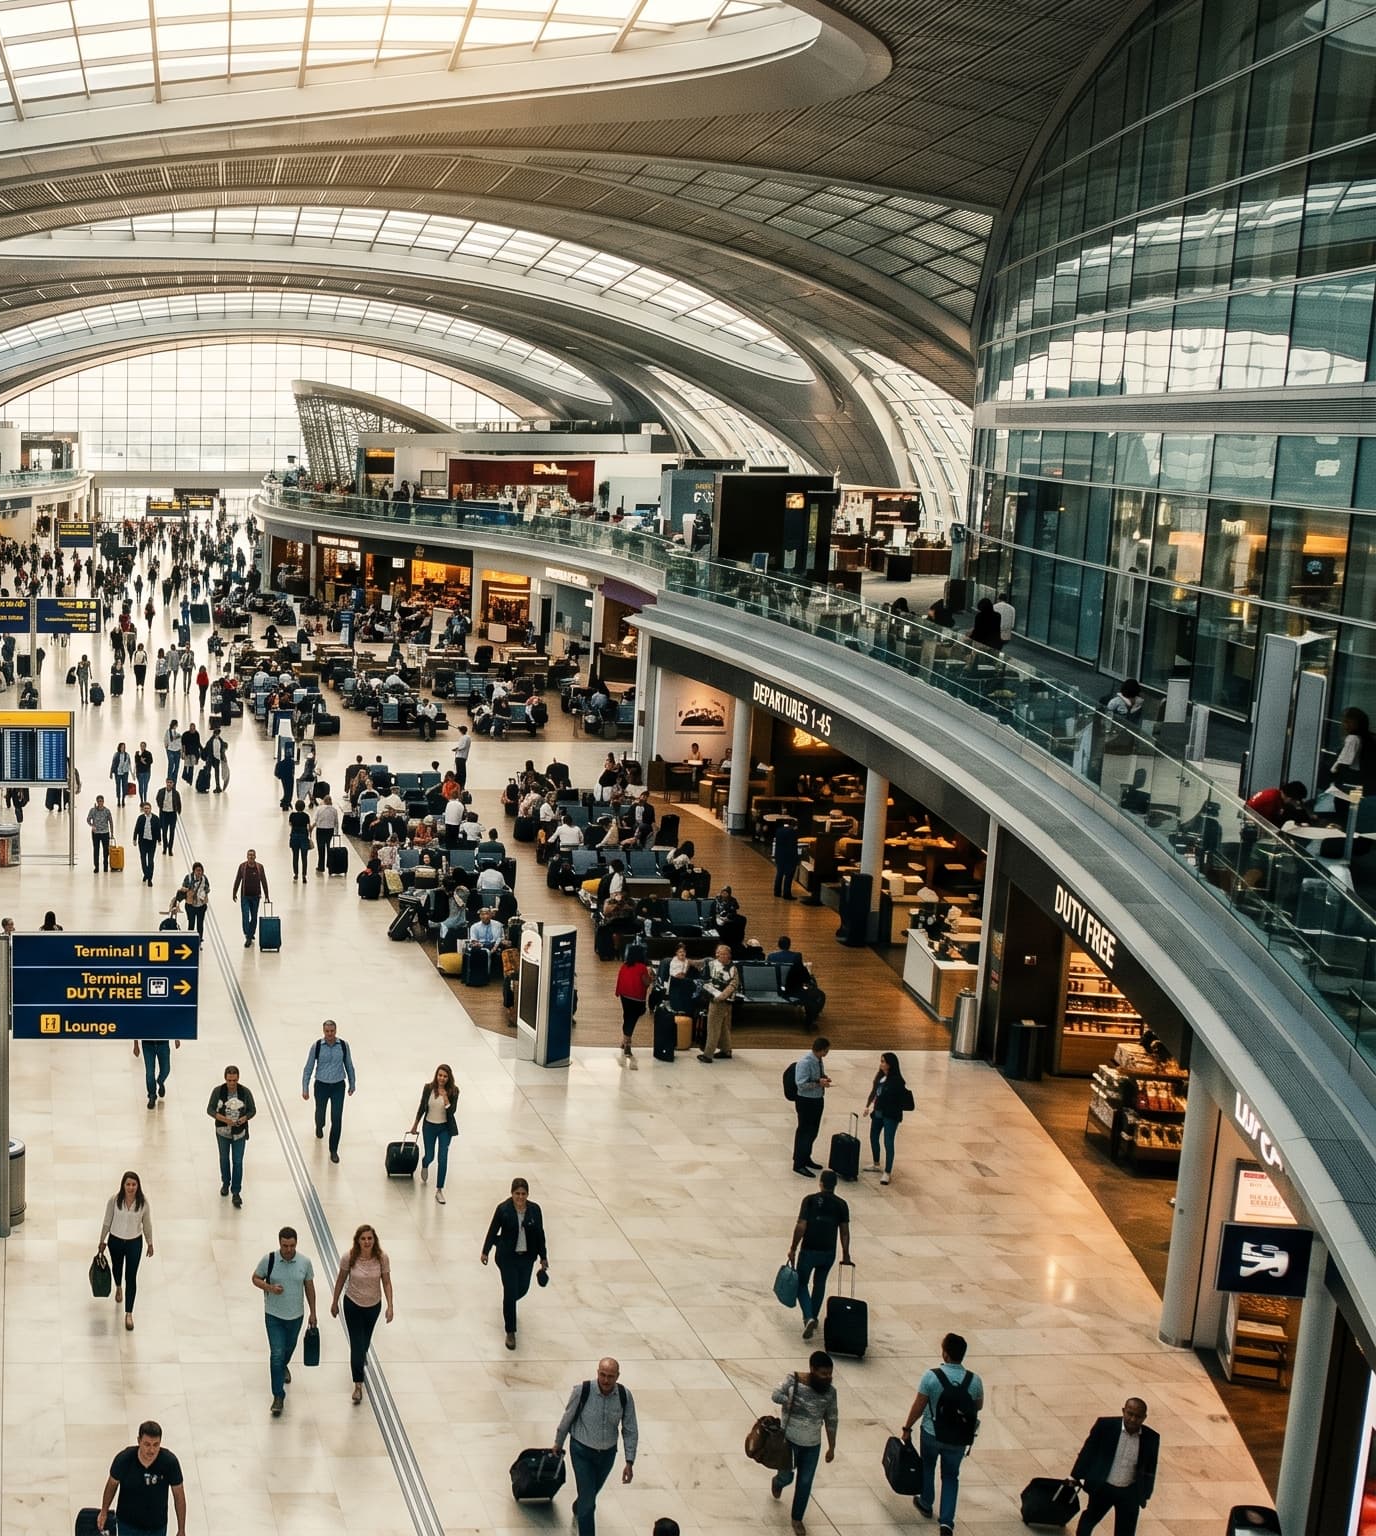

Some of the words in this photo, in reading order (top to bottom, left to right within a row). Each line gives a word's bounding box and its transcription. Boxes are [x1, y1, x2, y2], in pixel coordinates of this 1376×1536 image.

[753, 681, 809, 725] DEPARTURES
[1054, 884, 1086, 937] DUTY
[1085, 912, 1116, 969] FREE
[74, 944, 135, 958] Terminal
[81, 971, 142, 985] Terminal
[66, 987, 106, 999] DUTY
[108, 987, 143, 999] FREE
[65, 1020, 117, 1036] Lounge
